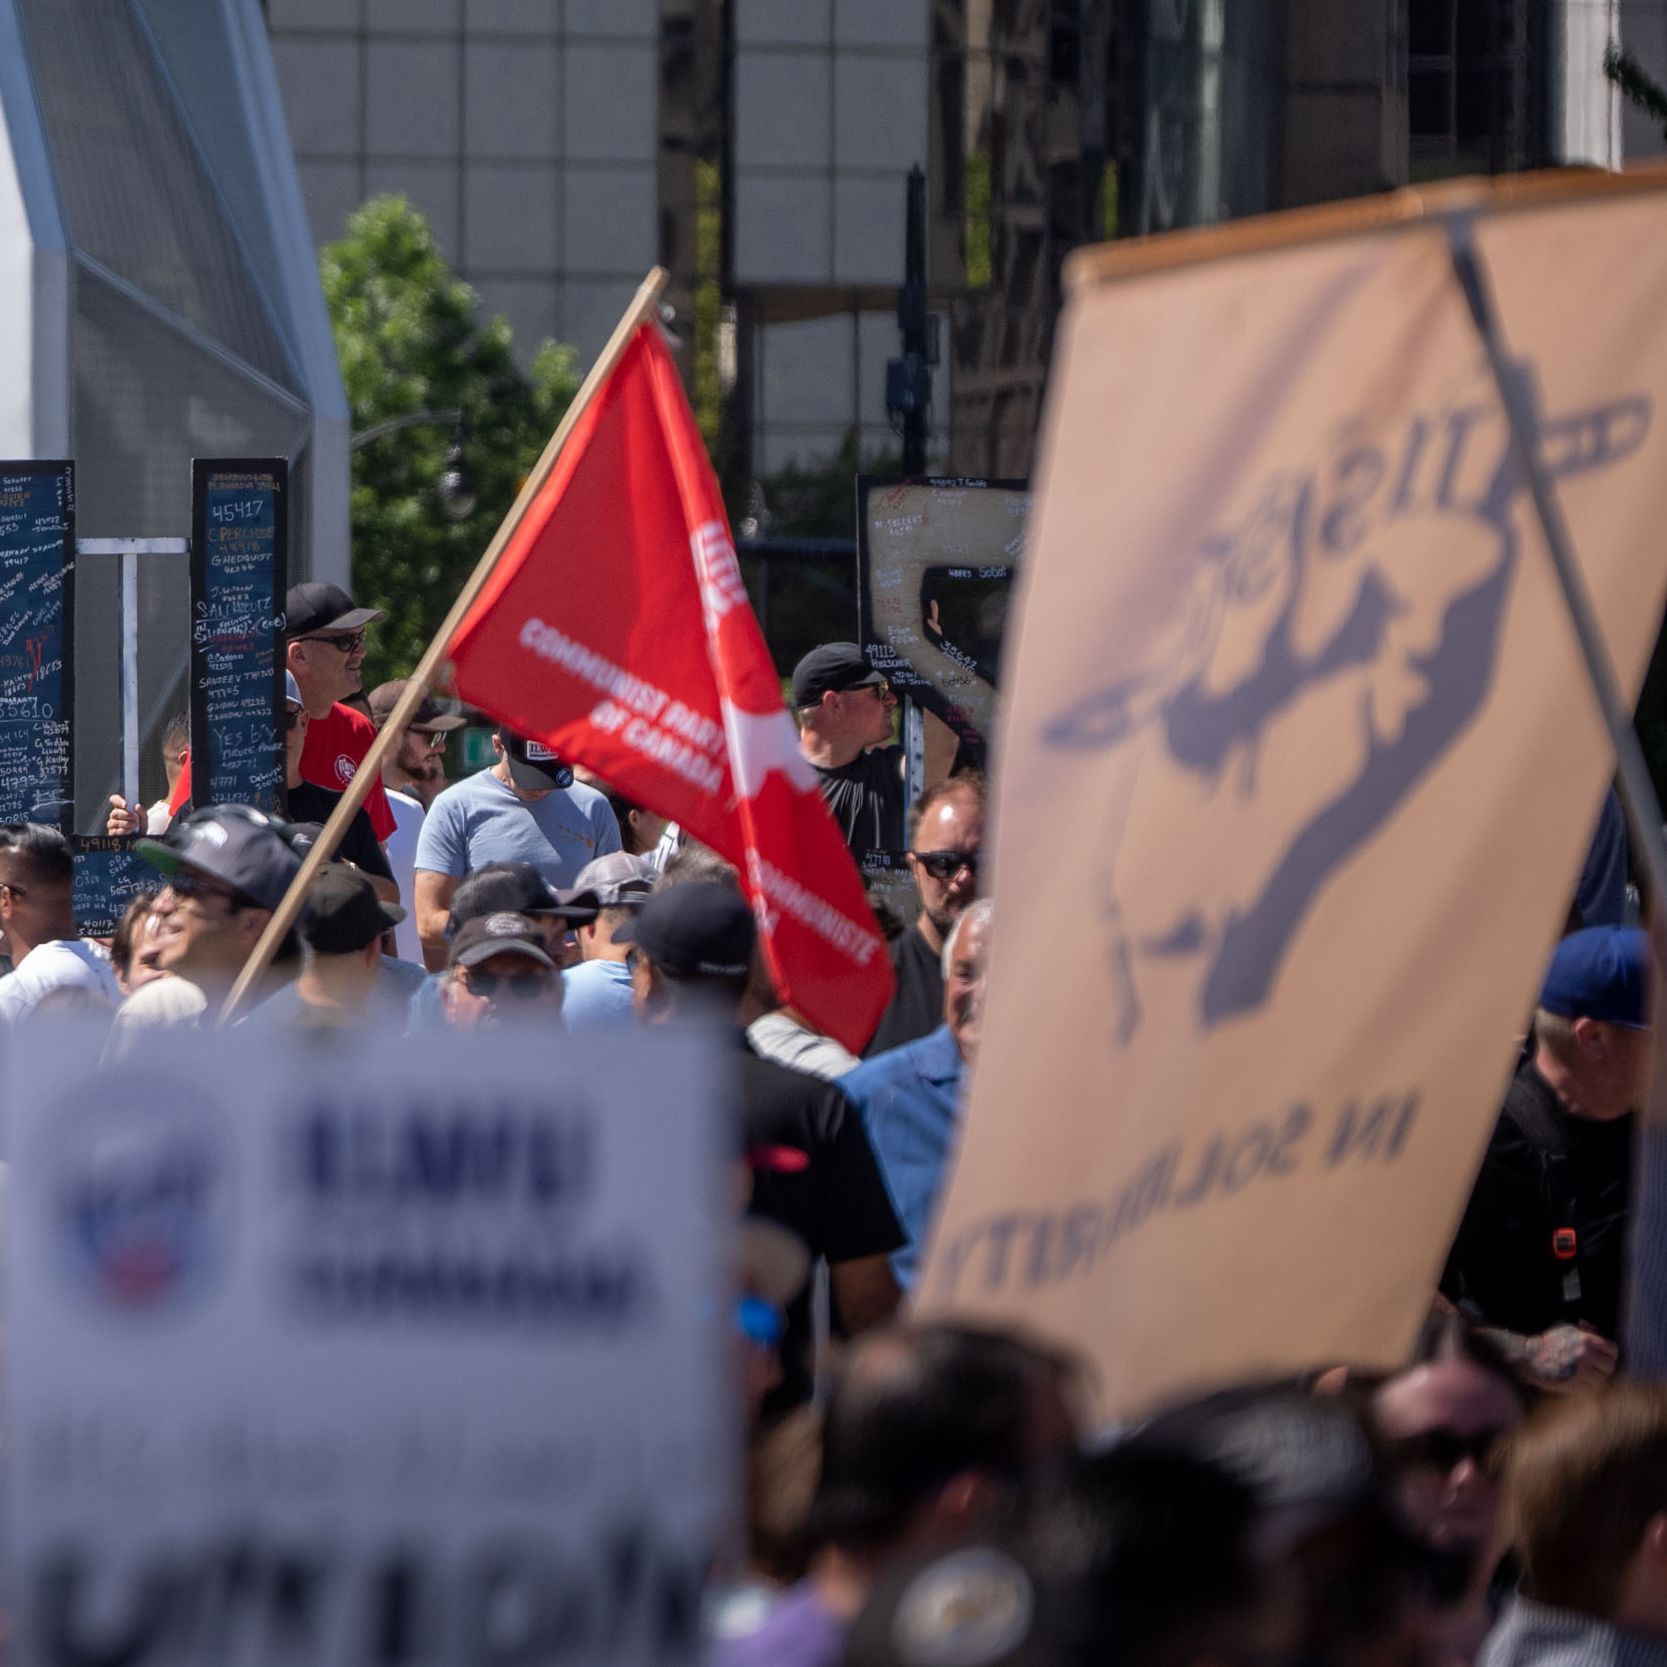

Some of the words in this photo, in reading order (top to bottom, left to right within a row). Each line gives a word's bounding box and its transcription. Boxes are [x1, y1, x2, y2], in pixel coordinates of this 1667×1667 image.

[213, 500, 265, 522] 45417
[520, 618, 671, 720] COMMUNIST
[529, 742, 550, 754] ILW
[589, 699, 632, 735] OF
[621, 716, 724, 796] CANADA
[80, 838, 121, 852] 49118
